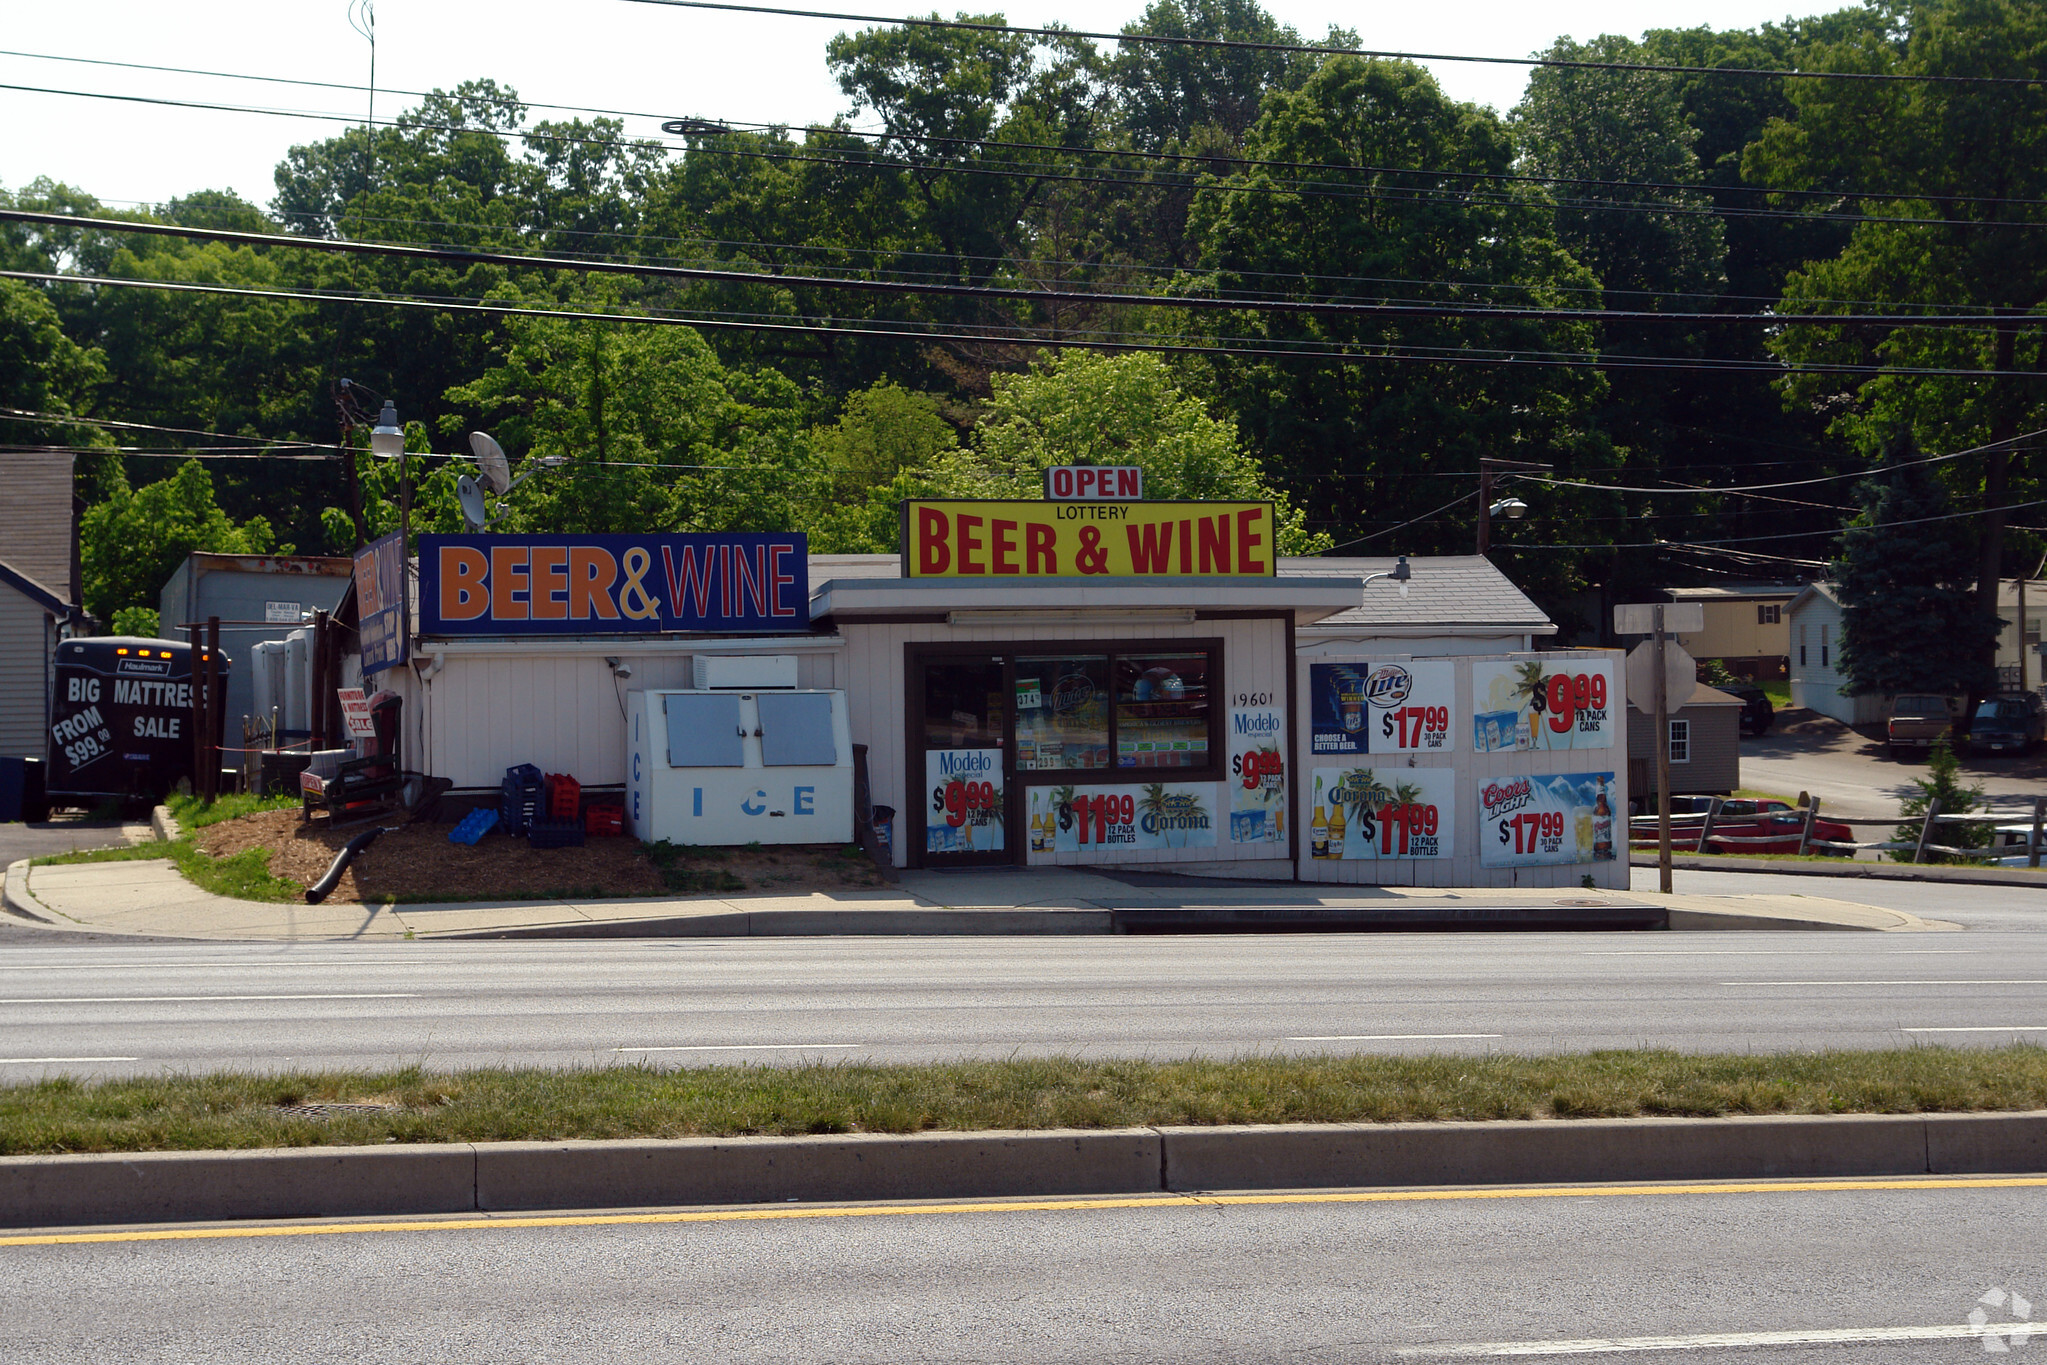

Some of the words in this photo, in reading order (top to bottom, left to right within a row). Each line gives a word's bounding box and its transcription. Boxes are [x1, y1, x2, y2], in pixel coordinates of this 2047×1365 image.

[1053, 468, 1139, 497] OPEN
[1056, 505, 1129, 521] LOTTERY
[919, 506, 1058, 575] BEER
[1075, 525, 1110, 575] &
[1126, 508, 1265, 574] WINE
[439, 545, 621, 621] BEER
[619, 547, 661, 621] &
[661, 544, 796, 619] WINE
[124, 661, 164, 673] Haulmark
[68, 677, 100, 702] BIG
[1368, 675, 1410, 698] Lite
[1233, 692, 1273, 707] 19601
[1575, 711, 1585, 721] 12
[1587, 710, 1608, 720] PACK
[52, 705, 104, 745] FROM
[133, 716, 180, 739] SALE
[350, 719, 373, 729] SALE
[1234, 713, 1280, 734] Modelo
[1579, 722, 1600, 732] CANS
[1314, 734, 1340, 742] CHOOSE
[1340, 734, 1347, 742] A
[1428, 740, 1442, 748] CANS
[1314, 742, 1339, 750] BETTER
[940, 751, 991, 775] Modelo
[693, 786, 815, 817] ICE
[1328, 786, 1386, 806] Corona
[1481, 780, 1531, 808] Coors
[967, 809, 976, 819] 12
[1488, 794, 1530, 821] LIGHT
[971, 818, 987, 827] CANS
[1107, 825, 1116, 834] 12
[1117, 824, 1136, 834] PACK
[1141, 812, 1211, 836] Corona
[1107, 834, 1136, 844] BOTTLES
[1421, 837, 1439, 846] PACK
[1540, 838, 1548, 846] 30
[1549, 837, 1563, 845] PACK
[1410, 846, 1439, 856] BOTTLES
[1544, 845, 1559, 853] CANS
